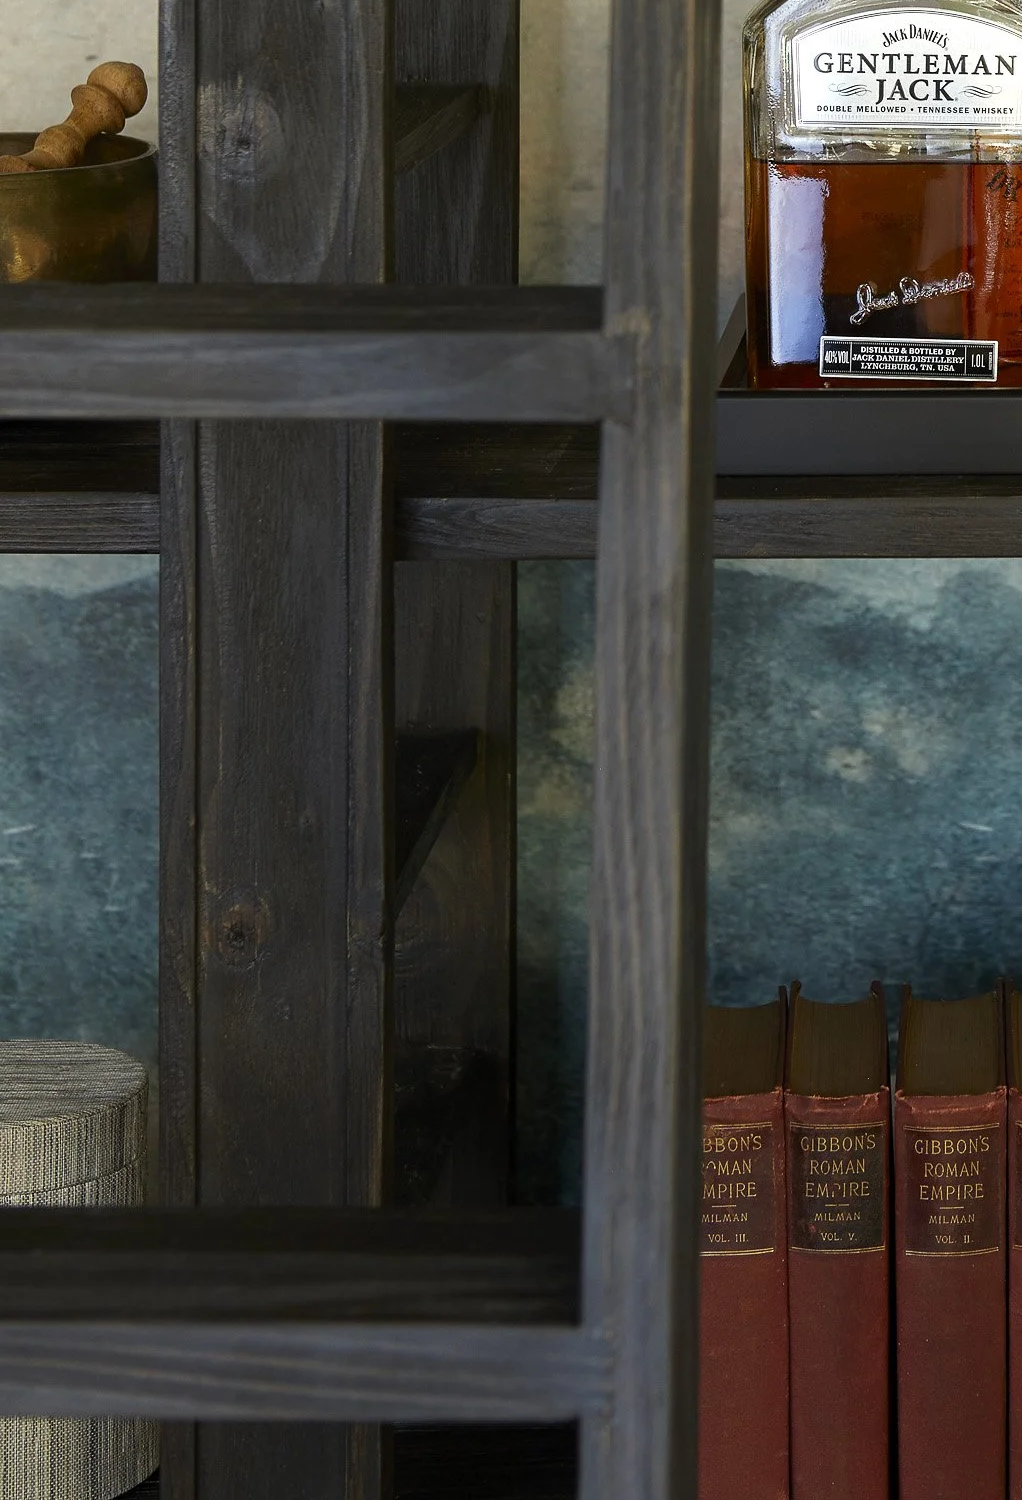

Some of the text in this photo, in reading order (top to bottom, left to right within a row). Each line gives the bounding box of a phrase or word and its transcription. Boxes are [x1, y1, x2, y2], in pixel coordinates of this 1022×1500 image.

[882, 23, 949, 49] JACK DANIEL'S
[813, 52, 1018, 76] GENTLEMAN
[875, 78, 955, 105] JACK
[816, 104, 1014, 115] DOUBLE MELLOWED TENNESSEE WHISKEY
[851, 353, 964, 364] JACK DANIEL DISTILLERY
[860, 346, 956, 356] DISTILLED & BOTTLED BY
[860, 362, 955, 372] LYNCHBURG, TN. USA
[800, 1132, 876, 1153] GIBBON'S
[914, 1135, 990, 1155] GIBBON'S
[809, 1158, 866, 1175] ROMAN
[924, 1161, 980, 1178] ROMAN
[919, 1183, 984, 1201] EMPIRE
[928, 1213, 975, 1225] MILMAN
